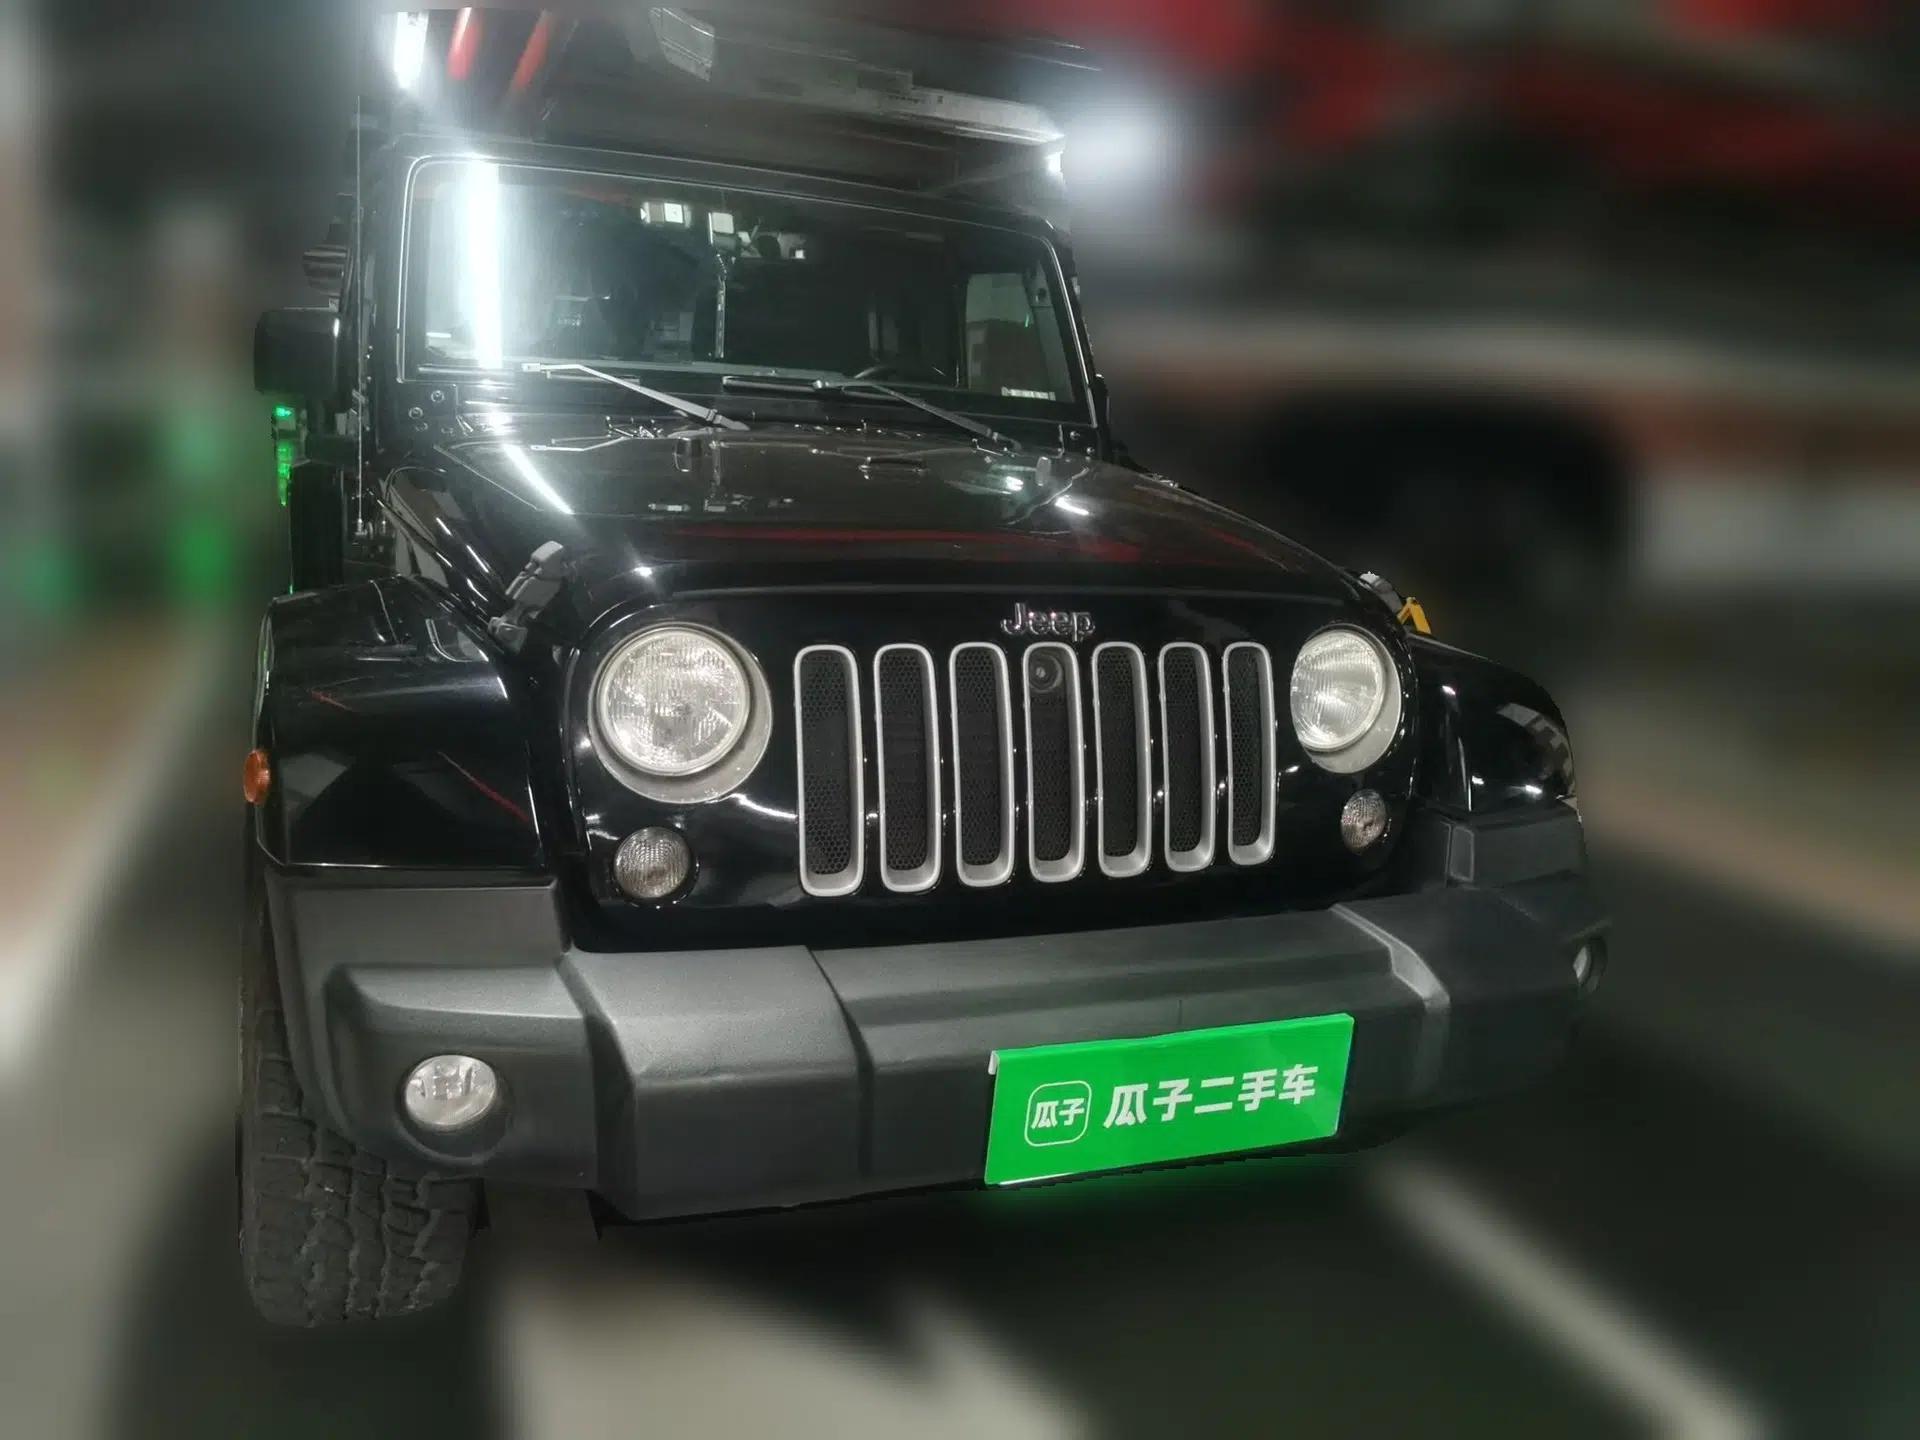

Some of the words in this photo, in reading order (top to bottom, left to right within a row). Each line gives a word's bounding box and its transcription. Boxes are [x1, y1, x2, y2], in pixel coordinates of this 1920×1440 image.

[1001, 602, 1096, 642] Jeep
[1031, 1097, 1085, 1130] 瓜子
[1103, 1063, 1319, 1129] 瓜子二手车
